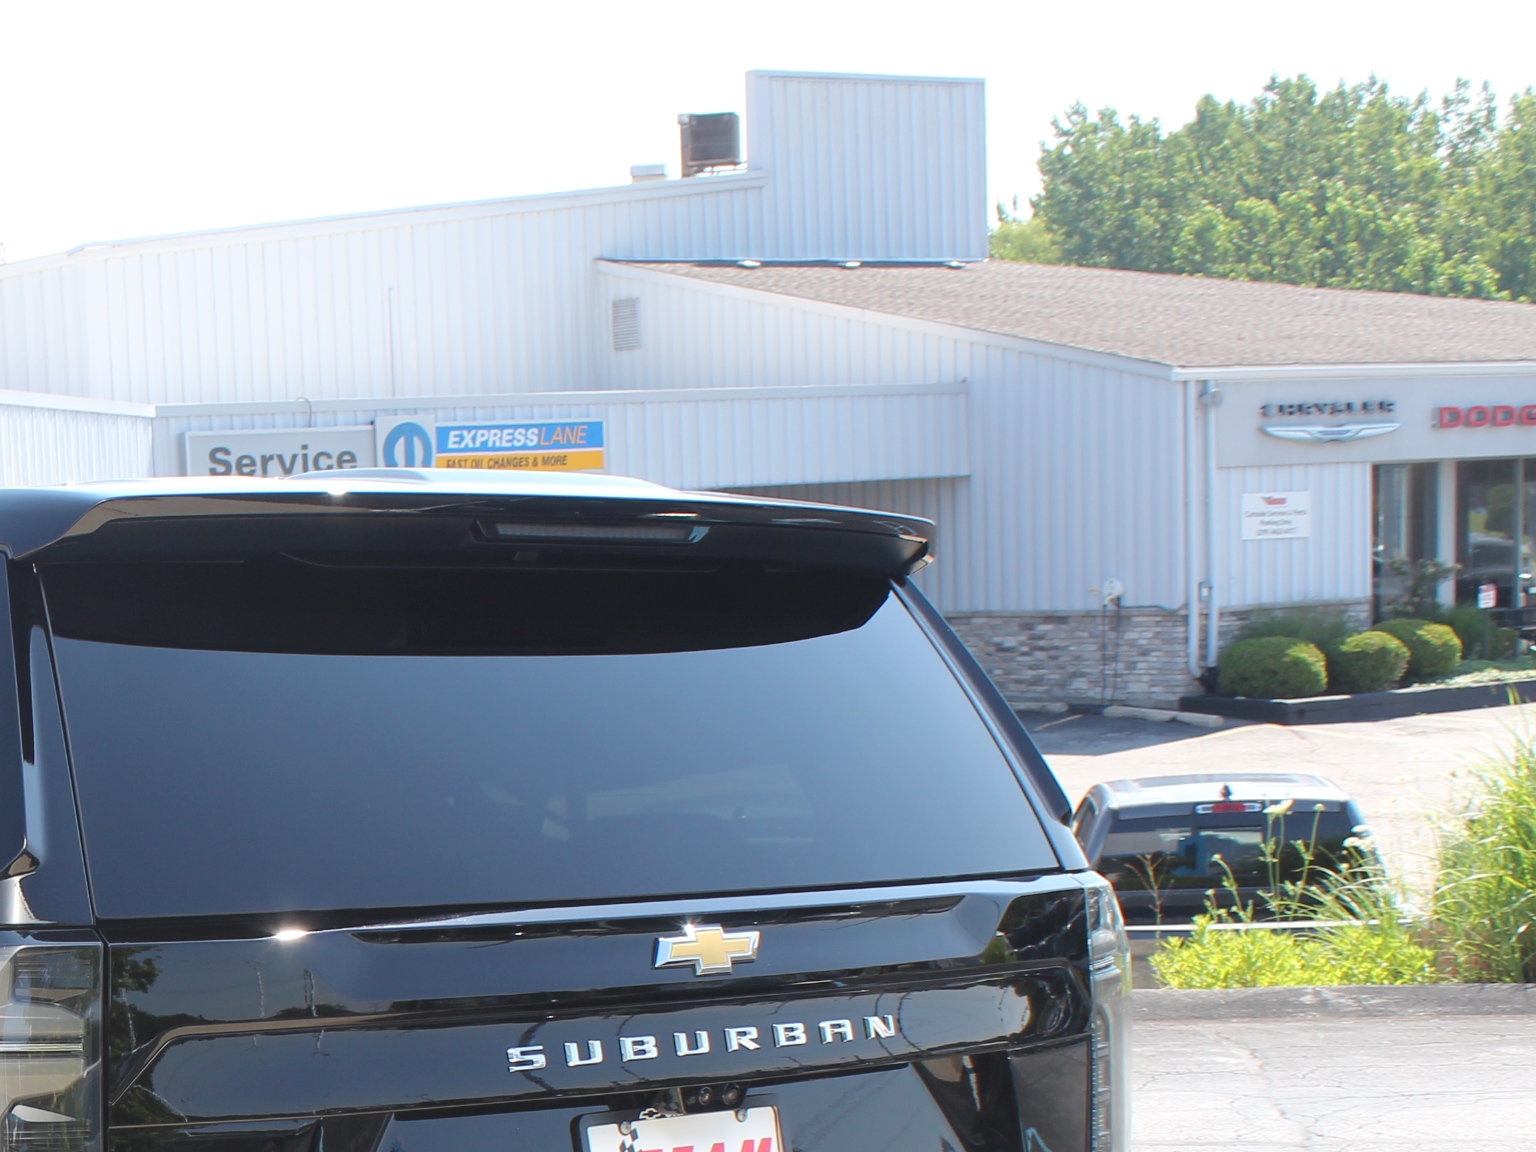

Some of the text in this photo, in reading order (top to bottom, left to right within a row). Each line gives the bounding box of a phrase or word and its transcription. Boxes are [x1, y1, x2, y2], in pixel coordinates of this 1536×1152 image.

[208, 444, 358, 477] Service
[487, 456, 530, 469] CHANGES
[531, 456, 539, 468] &
[541, 455, 568, 466] MORE
[506, 1014, 897, 1073] SUBURBAN
